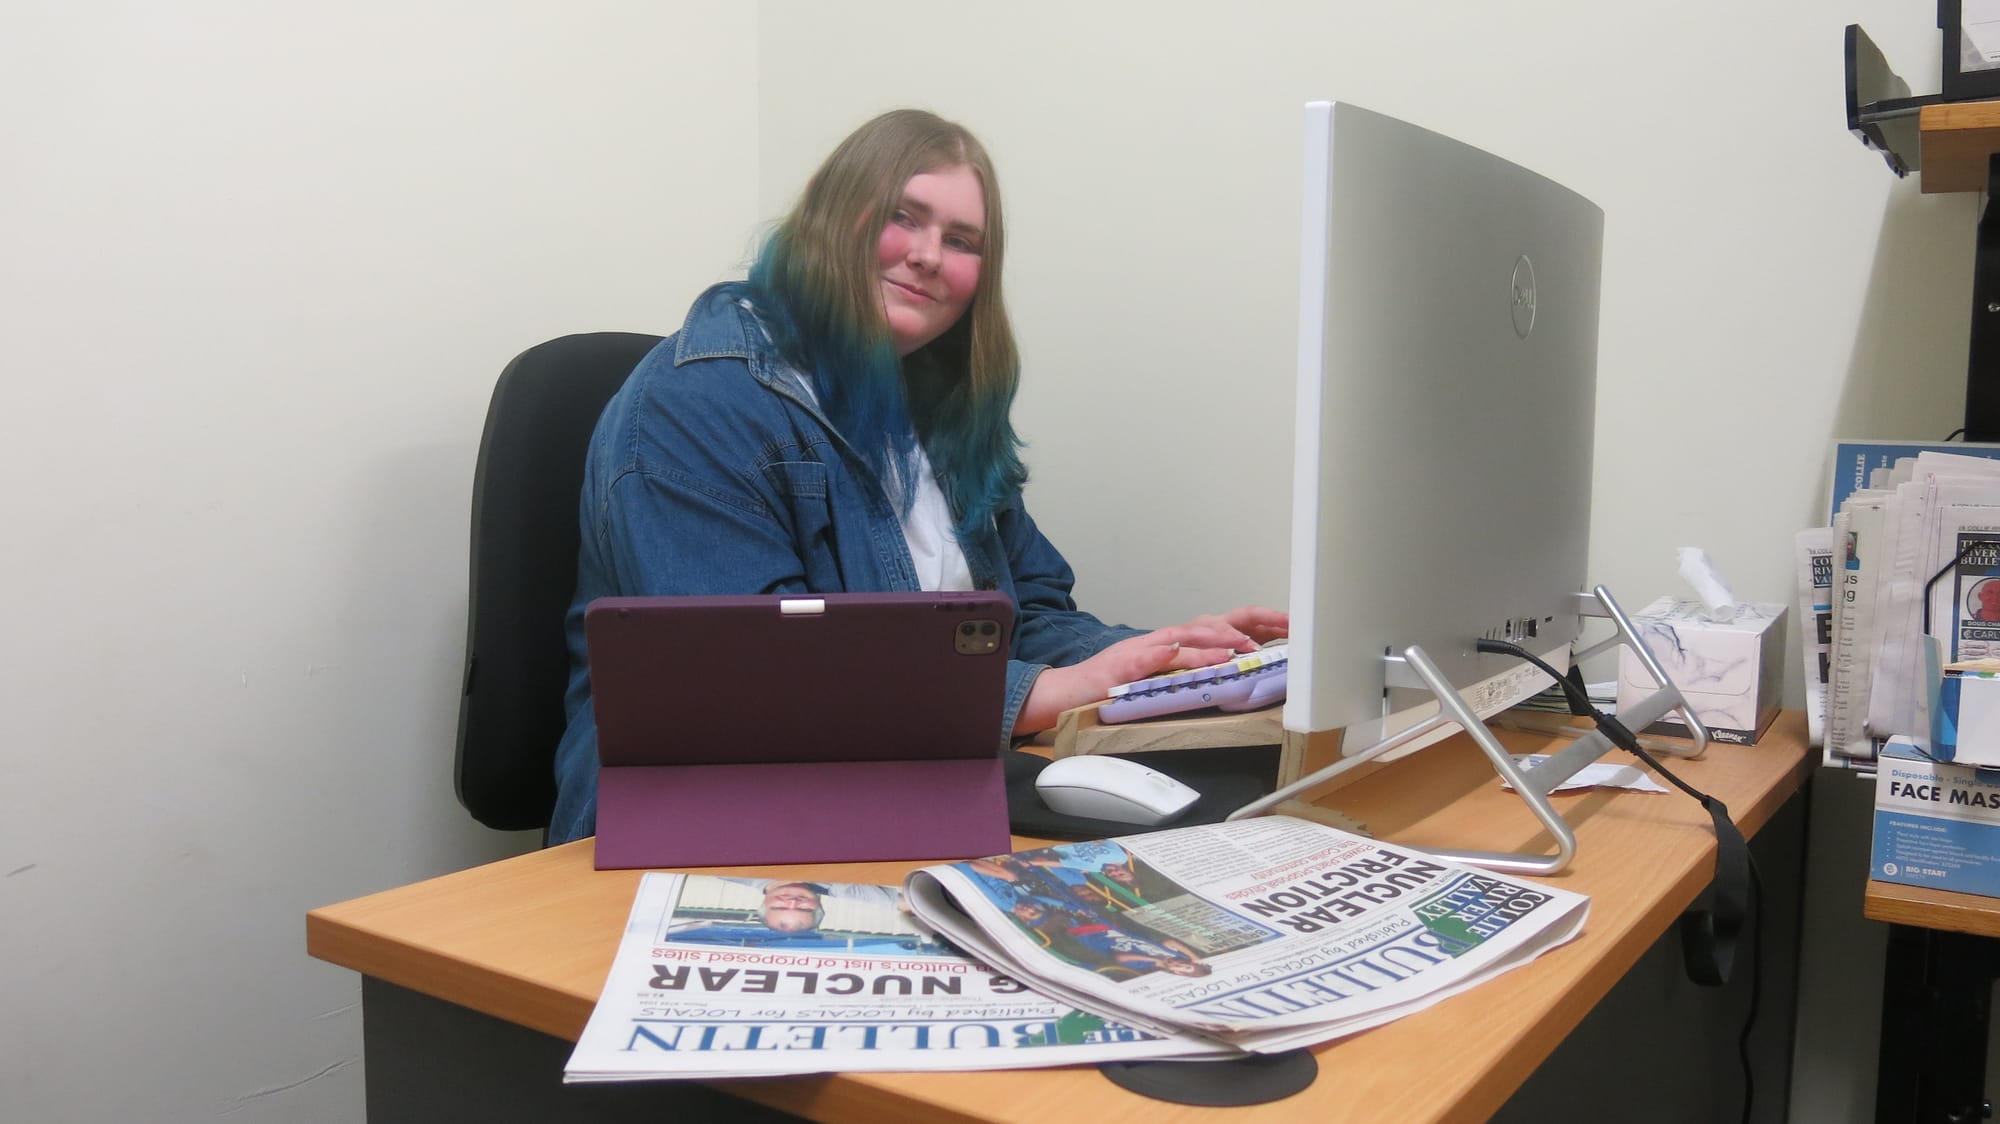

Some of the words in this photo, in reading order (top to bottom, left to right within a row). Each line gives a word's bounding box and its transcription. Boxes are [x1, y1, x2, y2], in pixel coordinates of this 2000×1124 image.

[1855, 453, 1866, 490] COLLIE
[1891, 769, 1944, 783] Disposable
[1890, 781, 1942, 802] FACE
[1922, 869, 1947, 878] START
[1240, 849, 1408, 918] FRICTION
[1275, 860, 1449, 934] NUCLEAR
[1417, 875, 1498, 922] VALLEY
[1448, 881, 1521, 923] RIVER
[1466, 891, 1546, 938] COLLIE
[1346, 918, 1411, 949] Published
[651, 948, 701, 960] sites
[708, 951, 810, 968] proposed
[1321, 944, 1349, 958] by
[816, 957, 837, 971] of
[844, 959, 872, 971] list
[880, 961, 968, 975] Dutton's
[1259, 954, 1323, 978] LOCALS
[648, 963, 962, 996] NUCLEAR
[1188, 927, 1476, 1020] BULLETIN
[1234, 971, 1262, 982] for
[1159, 979, 1233, 1004] LOCALS
[640, 1007, 741, 1018] LOCALS
[752, 1008, 786, 1019] for
[797, 1007, 895, 1018] LOCALS
[907, 1007, 934, 1019] by
[945, 1005, 1056, 1019] Published
[618, 1021, 1061, 1052] BULLETIN
